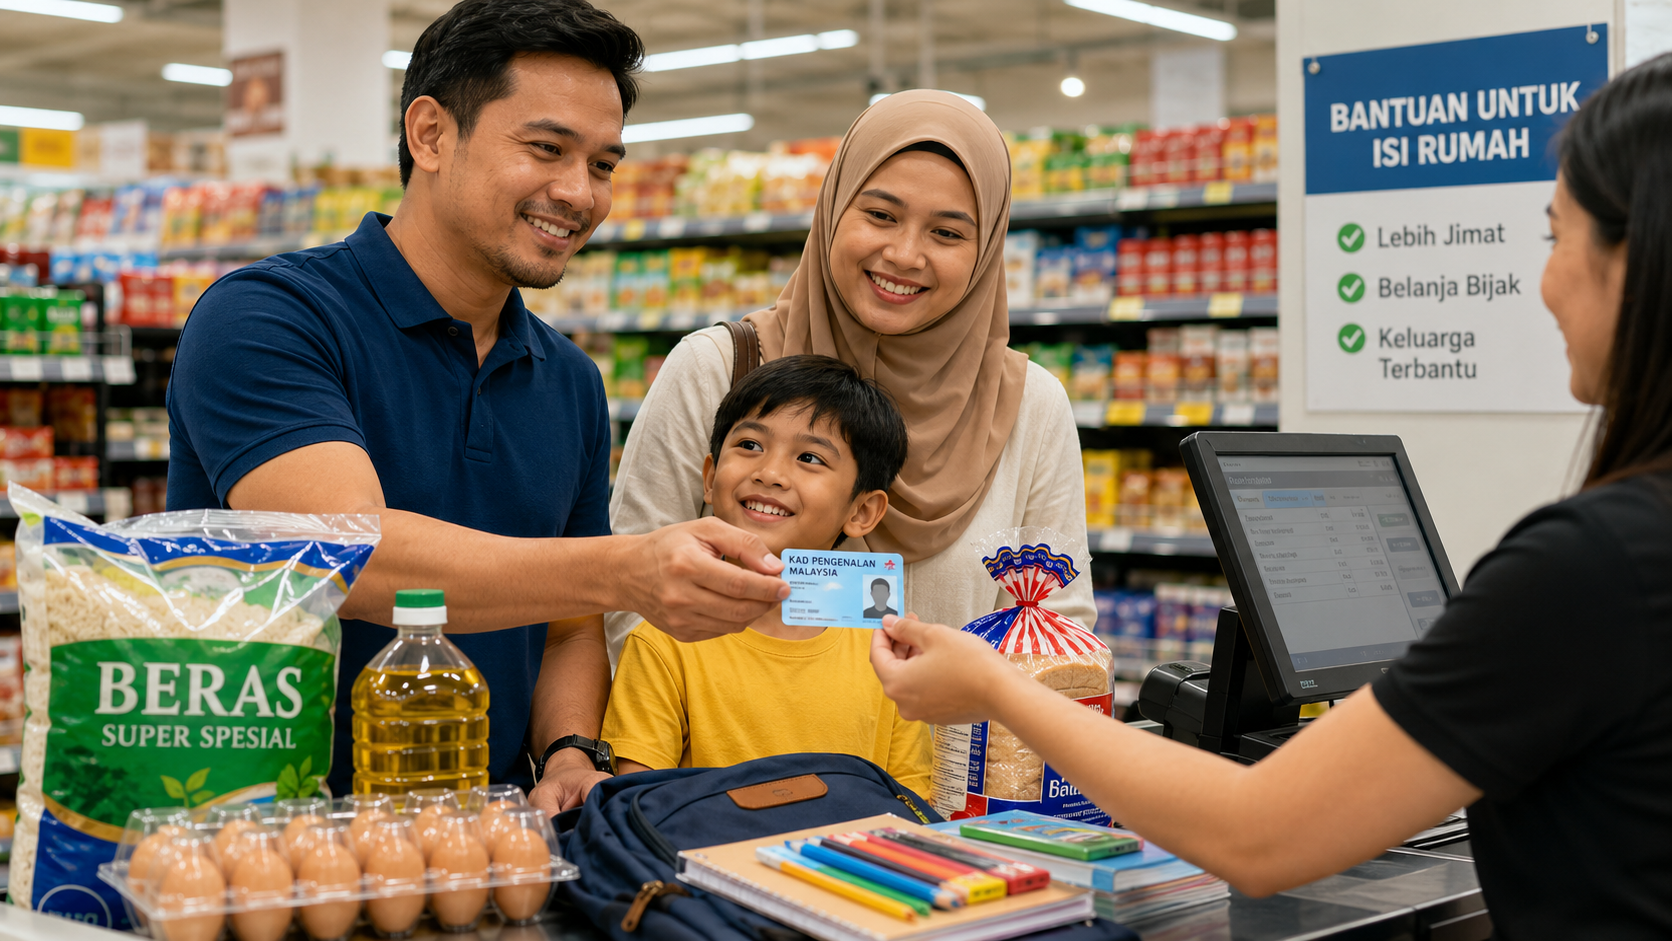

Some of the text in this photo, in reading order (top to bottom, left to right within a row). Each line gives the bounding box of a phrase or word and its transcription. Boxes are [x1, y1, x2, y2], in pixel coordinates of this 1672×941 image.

[1330, 80, 1582, 133] BANTUAN UNTUK
[1373, 127, 1530, 168] ISI RUMAH
[1377, 223, 1506, 248] Lebih Jimat
[1378, 272, 1521, 303] Belanja Bijak
[1378, 327, 1475, 353] Keluarga
[1378, 357, 1477, 379] Terbantu
[789, 555, 876, 568] KAD PENGENALAN
[789, 567, 838, 577] MALAYSIA
[94, 661, 303, 719] BERAS
[101, 723, 297, 749] SUPER SPESIAL
